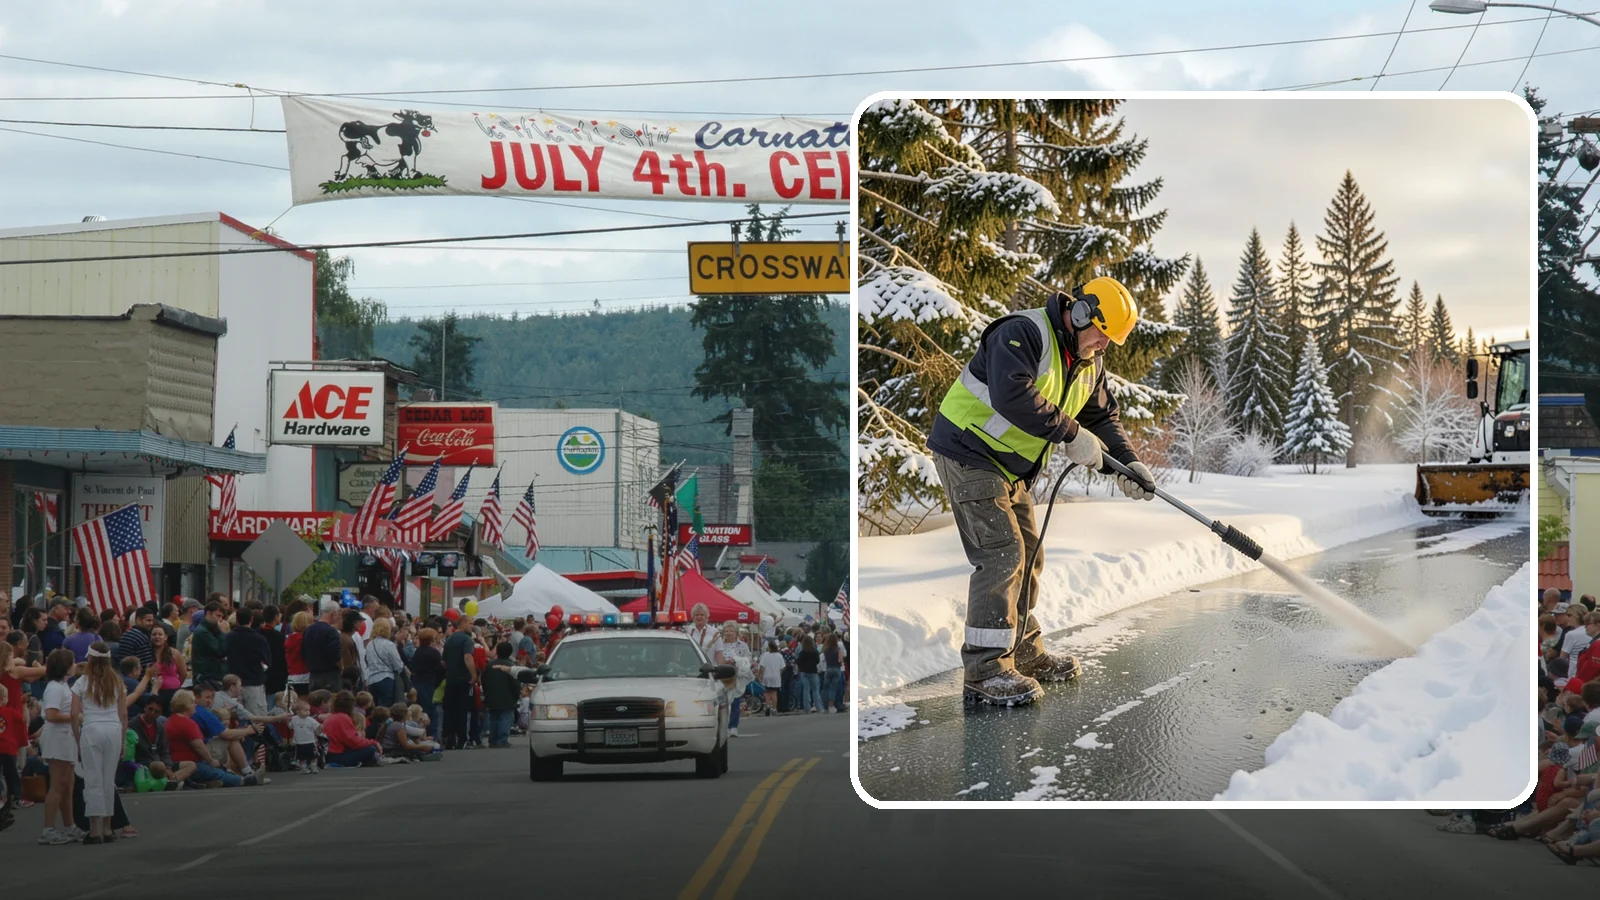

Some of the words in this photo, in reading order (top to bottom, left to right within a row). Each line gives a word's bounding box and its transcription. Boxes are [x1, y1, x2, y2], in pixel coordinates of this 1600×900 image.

[481, 141, 604, 192] JULY
[632, 150, 746, 198] 4th.
[696, 254, 850, 281] CROSSWA
[283, 380, 373, 420] ACE
[406, 409, 452, 422] CEDAR
[460, 409, 486, 422] LOG
[283, 421, 370, 436] Hardware
[416, 428, 477, 447] Coca-Cola
[354, 467, 386, 480] Simpl
[83, 485, 94, 494] St.
[96, 485, 124, 494] Vincent
[126, 485, 135, 494] de
[138, 486, 155, 495] Paul
[688, 526, 741, 535] CRNATION
[699, 535, 730, 543] GLASS
